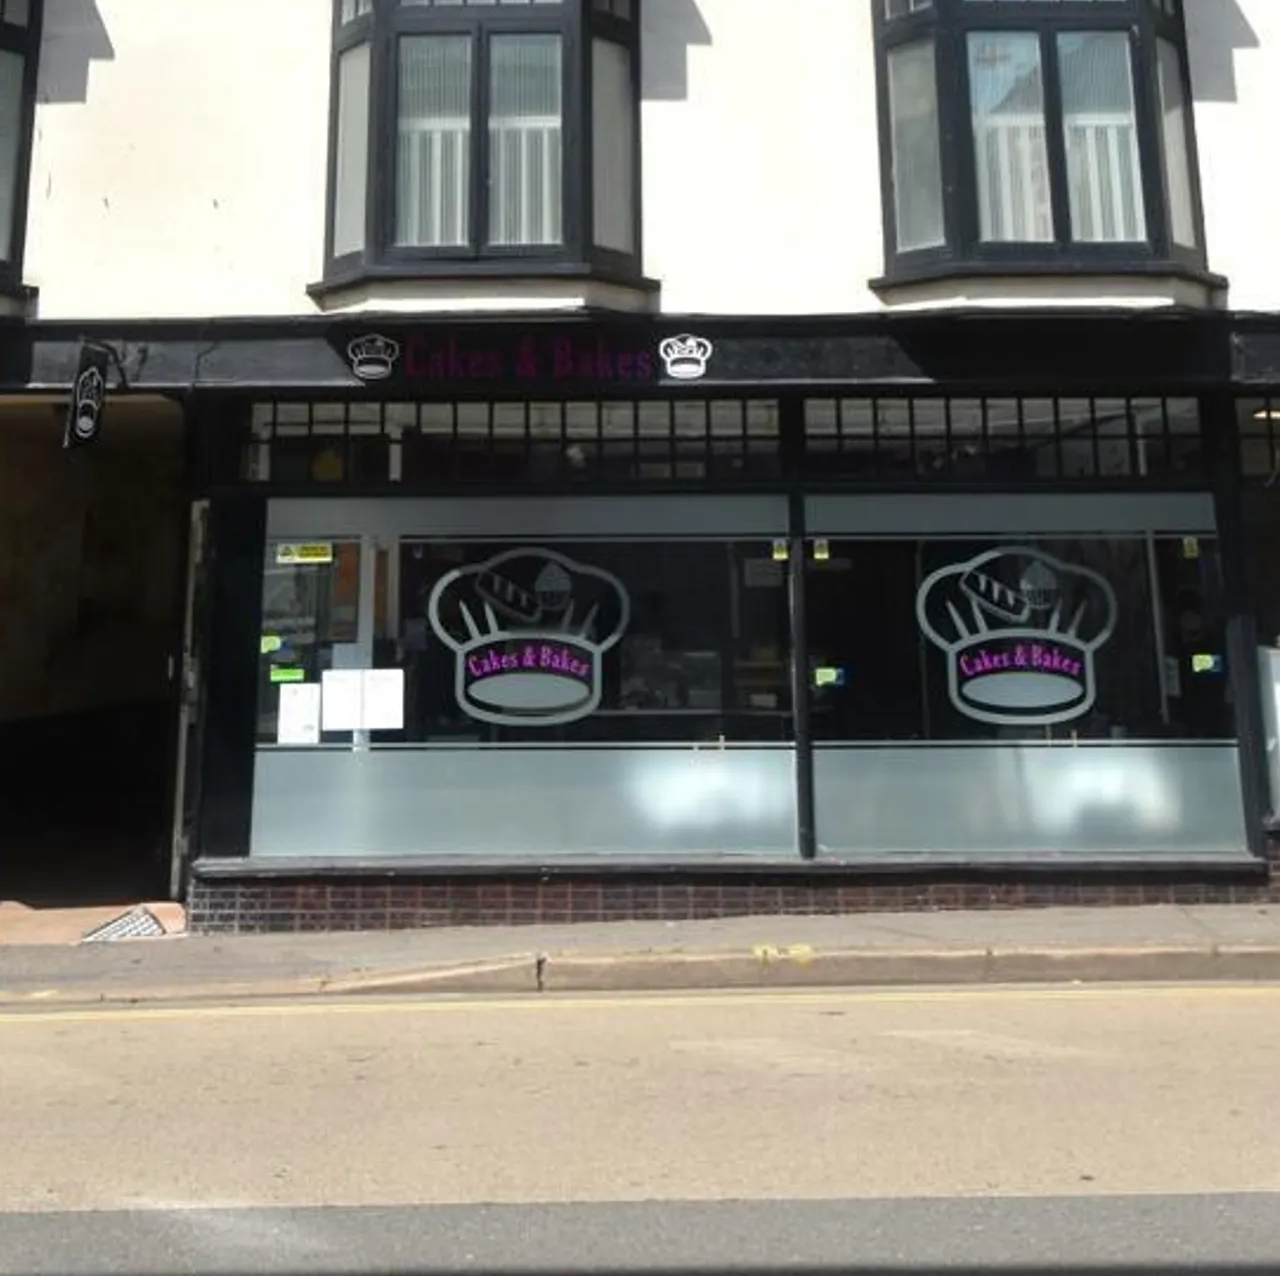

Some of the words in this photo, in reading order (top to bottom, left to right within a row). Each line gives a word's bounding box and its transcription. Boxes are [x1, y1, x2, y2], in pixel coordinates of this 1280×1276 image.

[402, 332, 502, 379] Cakes
[516, 335, 541, 379] &
[552, 333, 653, 379] Bakes
[468, 649, 519, 677] Cakes
[522, 645, 536, 667] &
[540, 645, 590, 676] Bakes
[960, 649, 1010, 676] Cakes
[1014, 645, 1028, 666] &
[1031, 644, 1081, 676] Bakes
